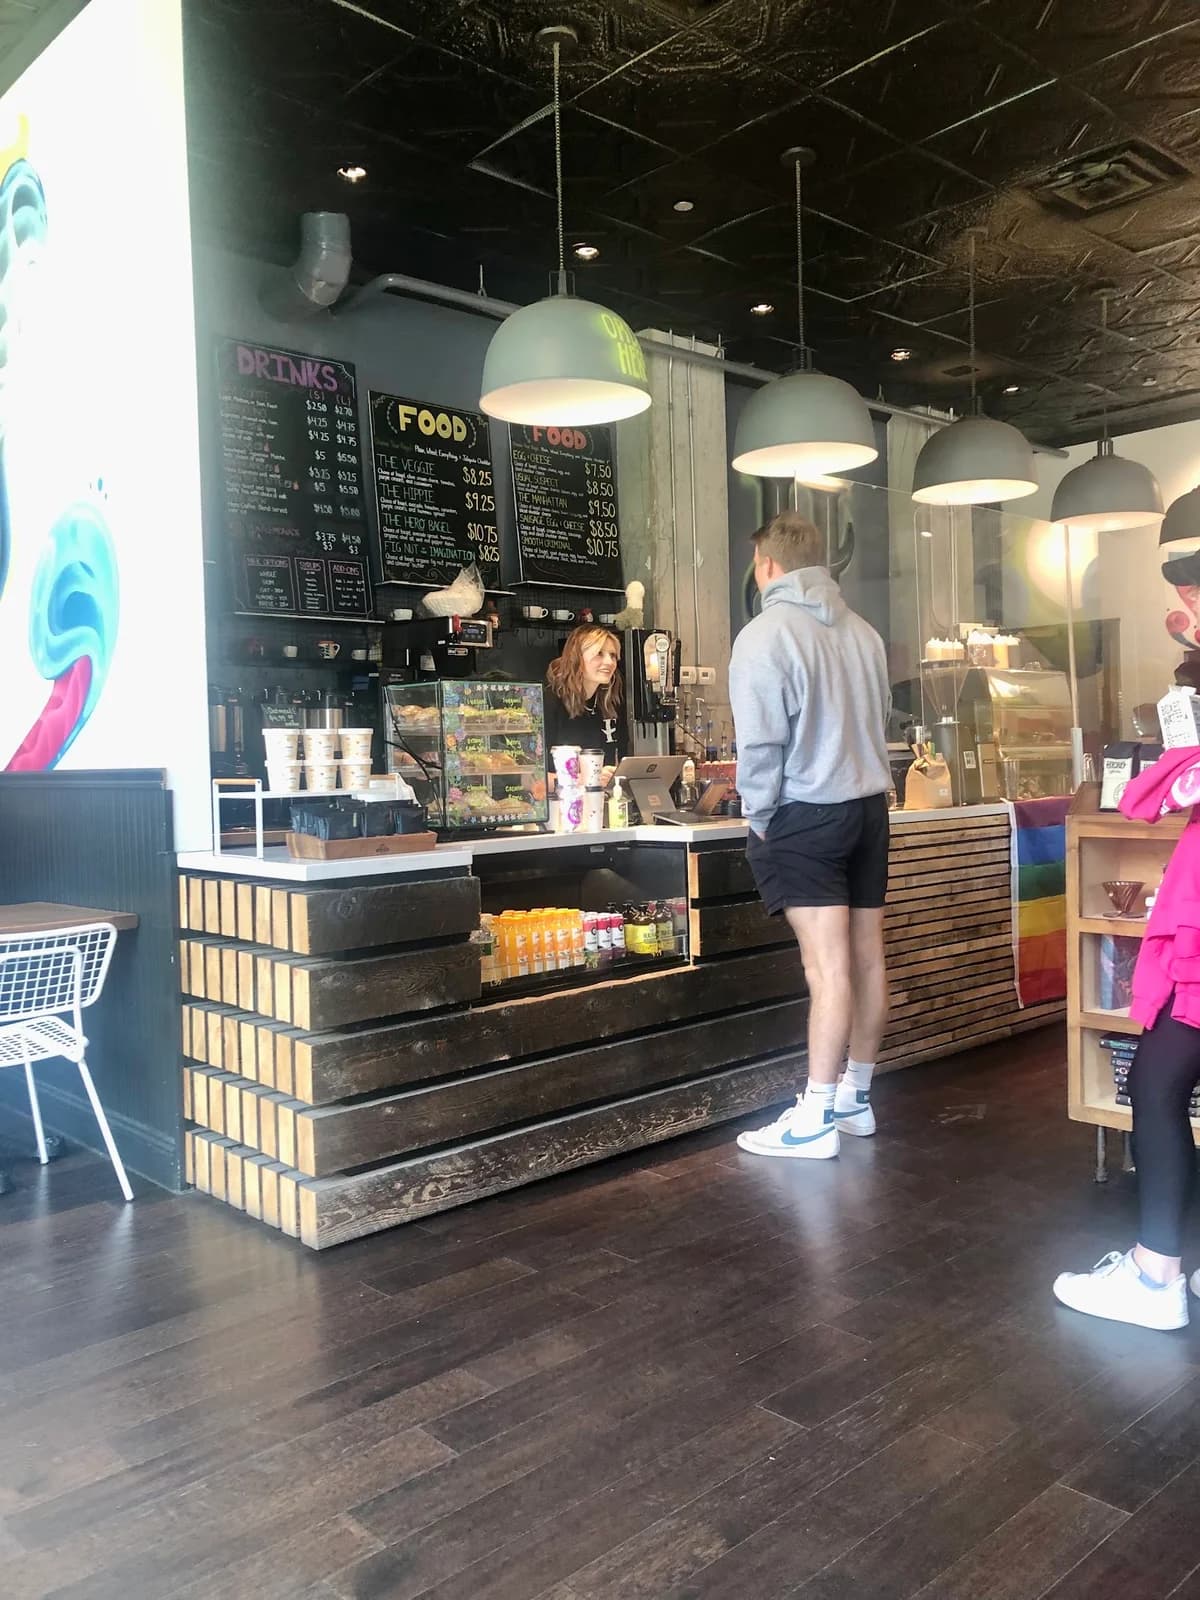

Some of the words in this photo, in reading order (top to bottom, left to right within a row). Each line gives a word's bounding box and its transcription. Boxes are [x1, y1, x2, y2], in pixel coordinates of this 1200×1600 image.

[236, 346, 338, 391] DRINKS
[399, 405, 467, 441] FOOD
[532, 425, 587, 450] FOOD
[376, 453, 399, 470] THE
[402, 458, 436, 476] VEGGIE
[462, 466, 492, 486] $8.25
[512, 449, 527, 461] EGG
[530, 453, 552, 466] CHEESE
[584, 462, 612, 479] $7.50
[379, 482, 401, 498] THE
[404, 486, 435, 503] HIPPIE
[465, 491, 495, 511] $9.25
[586, 479, 614, 497] $8.50
[518, 491, 530, 503] THE
[531, 494, 568, 508] MANHATTAN
[588, 500, 616, 518] $9.50
[382, 512, 401, 528] THE
[404, 516, 425, 530] HERO
[428, 519, 453, 534] BAGEL
[467, 522, 498, 543] $10.75
[520, 514, 545, 526] SAUSAGE
[563, 520, 585, 532] CHEESE
[589, 519, 618, 538] $8.50
[384, 541, 402, 553] FIG
[404, 543, 419, 555] NUT
[429, 546, 476, 561] IMAGINATION
[521, 537, 543, 547] SMOOTH
[586, 537, 619, 558] $10.75
